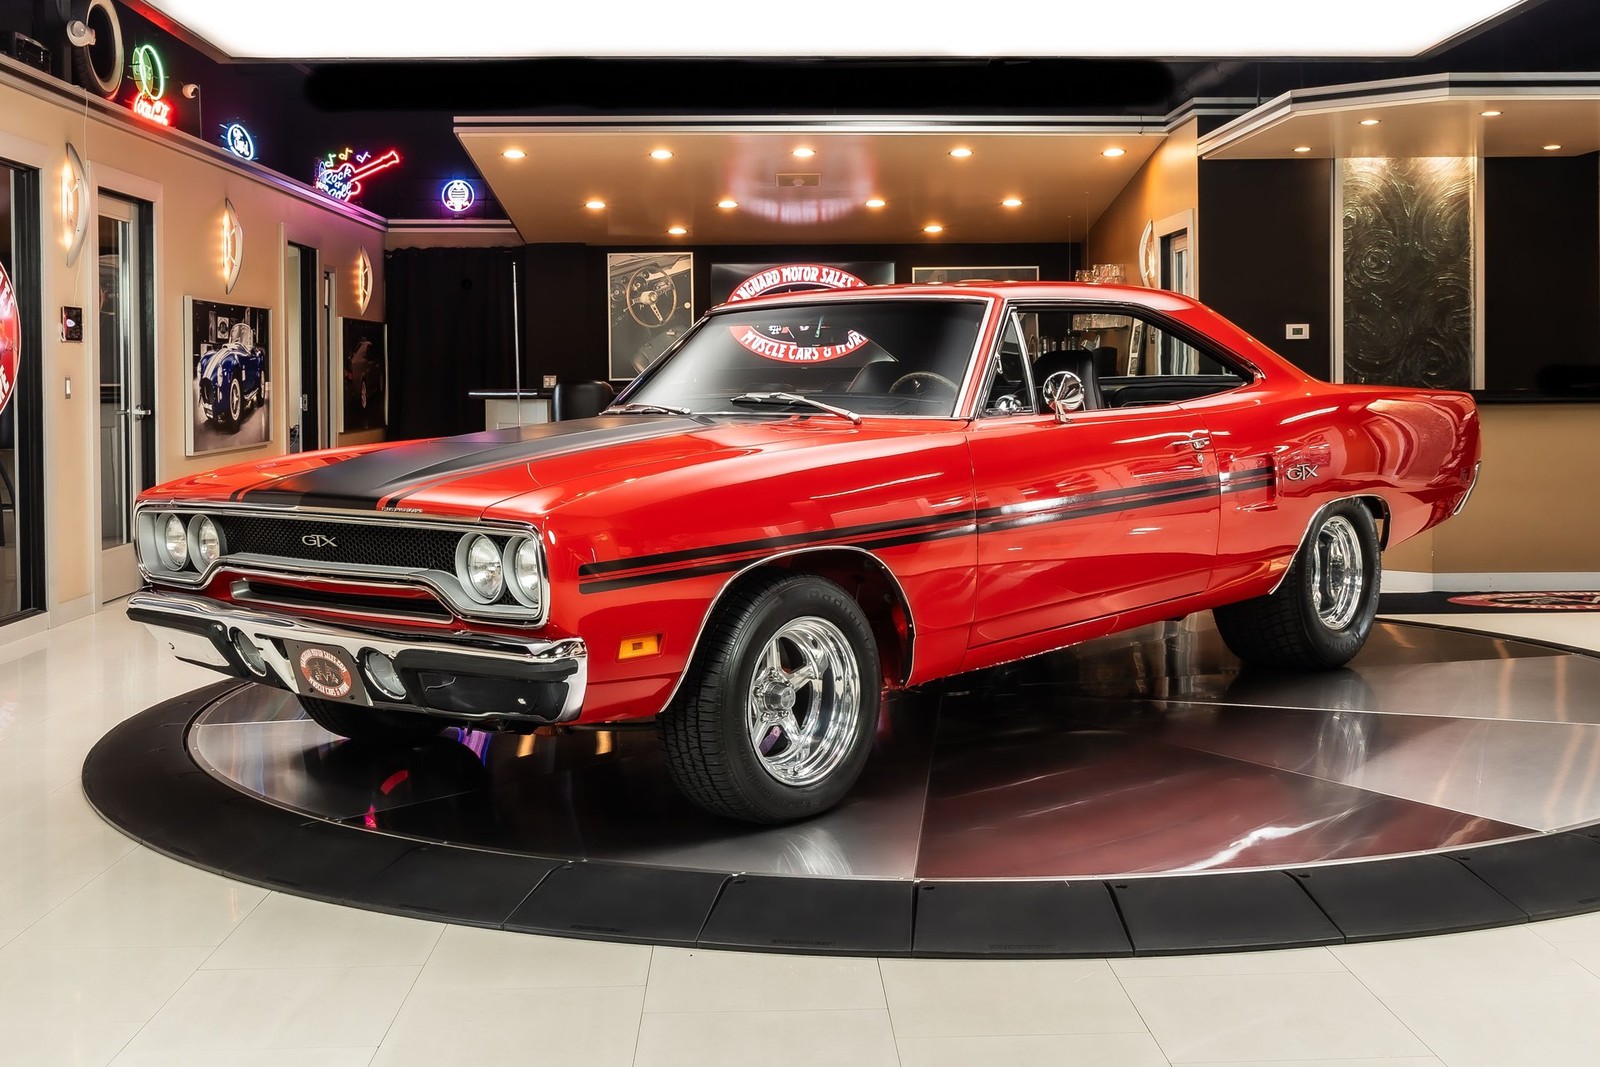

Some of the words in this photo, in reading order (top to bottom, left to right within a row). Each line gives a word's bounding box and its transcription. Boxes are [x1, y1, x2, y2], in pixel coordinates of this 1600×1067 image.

[324, 165, 352, 185] Rock
[781, 266, 819, 283] MOTOR
[740, 330, 787, 359] MUSCLE
[787, 343, 819, 360] CARS
[1286, 463, 1319, 481] GTX
[302, 534, 338, 548] GTX
